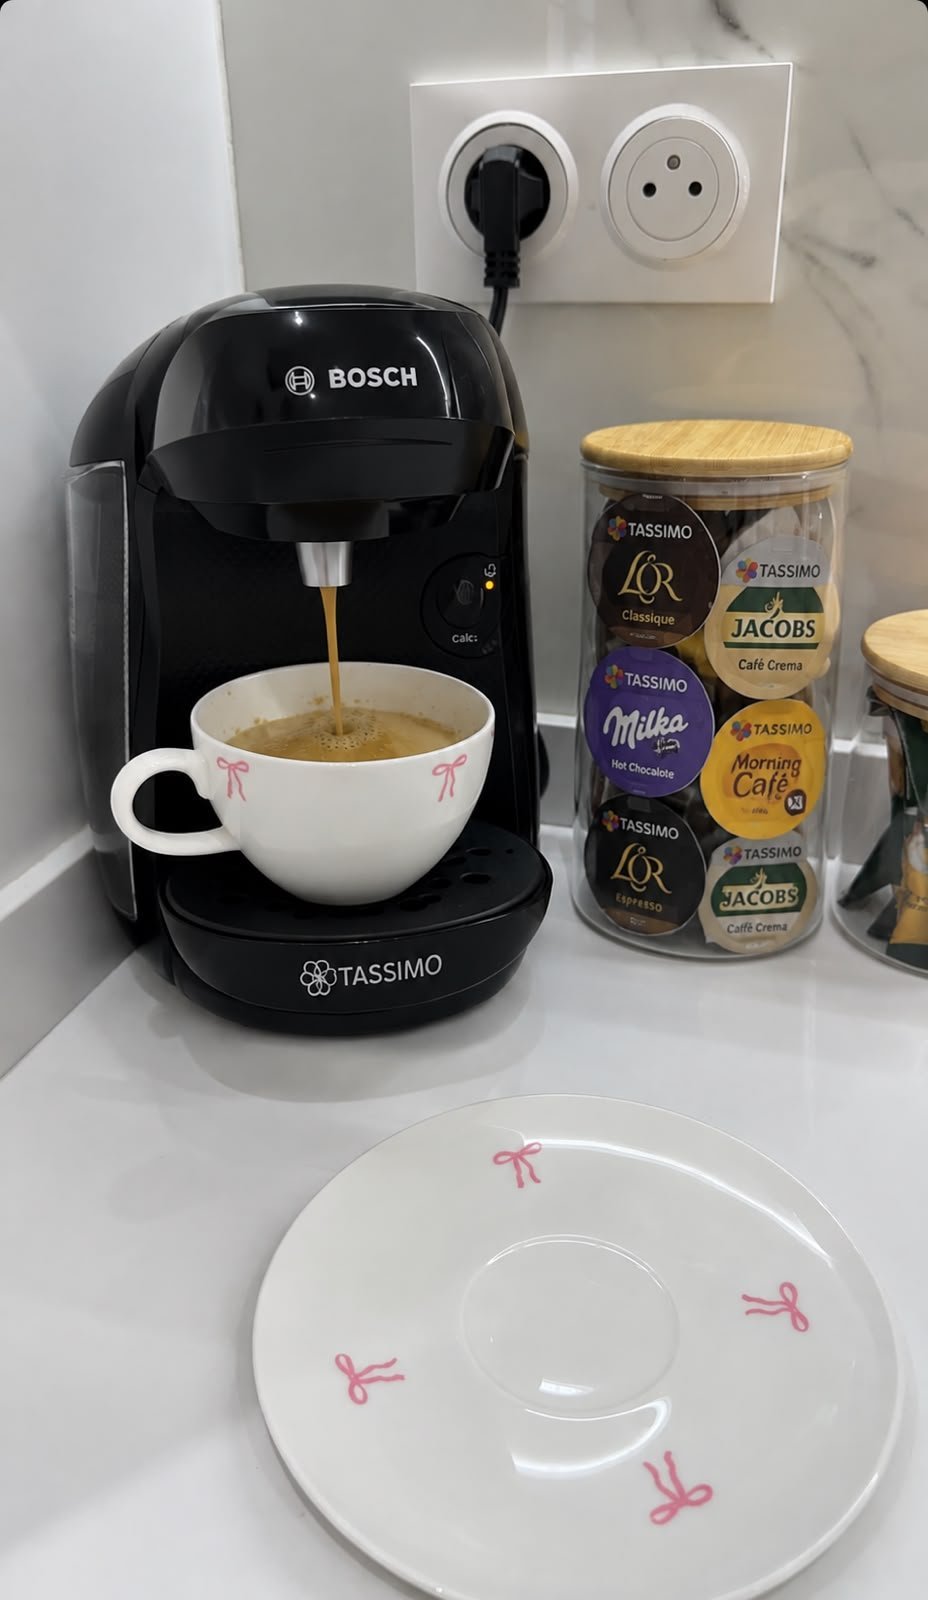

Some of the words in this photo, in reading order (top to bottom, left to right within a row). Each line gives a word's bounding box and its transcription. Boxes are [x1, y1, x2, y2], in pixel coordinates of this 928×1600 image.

[328, 366, 418, 389] BOSCH
[628, 522, 693, 540] TASSIMO
[759, 563, 821, 579] TASSIMO
[622, 609, 675, 626] Classique
[731, 618, 816, 638] JACOBS
[738, 658, 765, 671] Café
[767, 659, 803, 671] Crema
[624, 672, 688, 693] TASSIMO
[603, 706, 689, 750] Milka
[754, 723, 813, 736] TASSIMO
[611, 759, 627, 771] Hot
[731, 753, 802, 778] Morning
[733, 771, 789, 800] Café
[620, 817, 679, 840] TASSIMO
[744, 846, 802, 860] TASSIMO
[721, 888, 799, 908] JACOBS
[755, 922, 788, 933] Crema
[337, 954, 442, 986] TASSIMO
